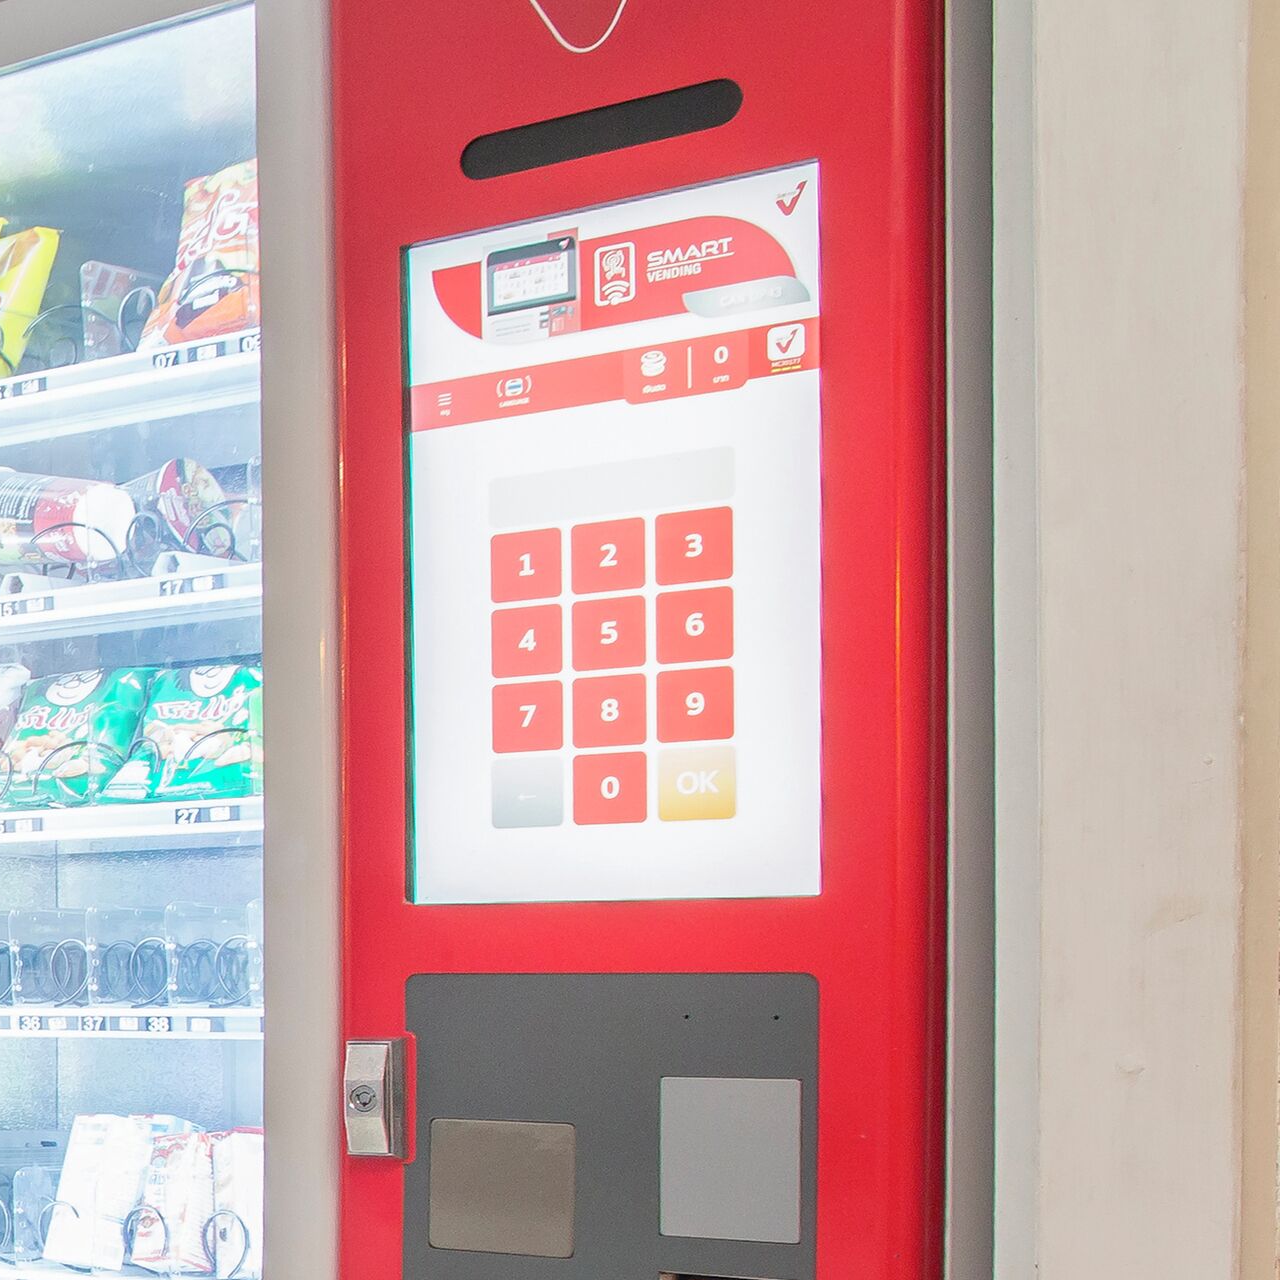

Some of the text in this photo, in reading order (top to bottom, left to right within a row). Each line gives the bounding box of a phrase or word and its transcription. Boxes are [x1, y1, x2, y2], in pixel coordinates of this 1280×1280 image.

[646, 237, 733, 267] SMART
[646, 262, 702, 283] VENDING
[155, 353, 177, 368] 07
[714, 346, 728, 364] 0
[599, 544, 618, 567] 2
[684, 534, 703, 558] 3
[519, 555, 535, 576] 1
[162, 581, 184, 596] 17
[600, 621, 618, 644] 5
[685, 612, 705, 637] 6
[518, 629, 537, 651] 4
[600, 699, 619, 722] 8
[685, 692, 705, 716] 9
[519, 705, 537, 728] 7
[601, 776, 620, 799] 0
[676, 769, 720, 796] OK
[178, 809, 200, 824] 27
[20, 1016, 40, 1031] 36
[83, 1016, 104, 1031] 37
[148, 1017, 169, 1032] 38
